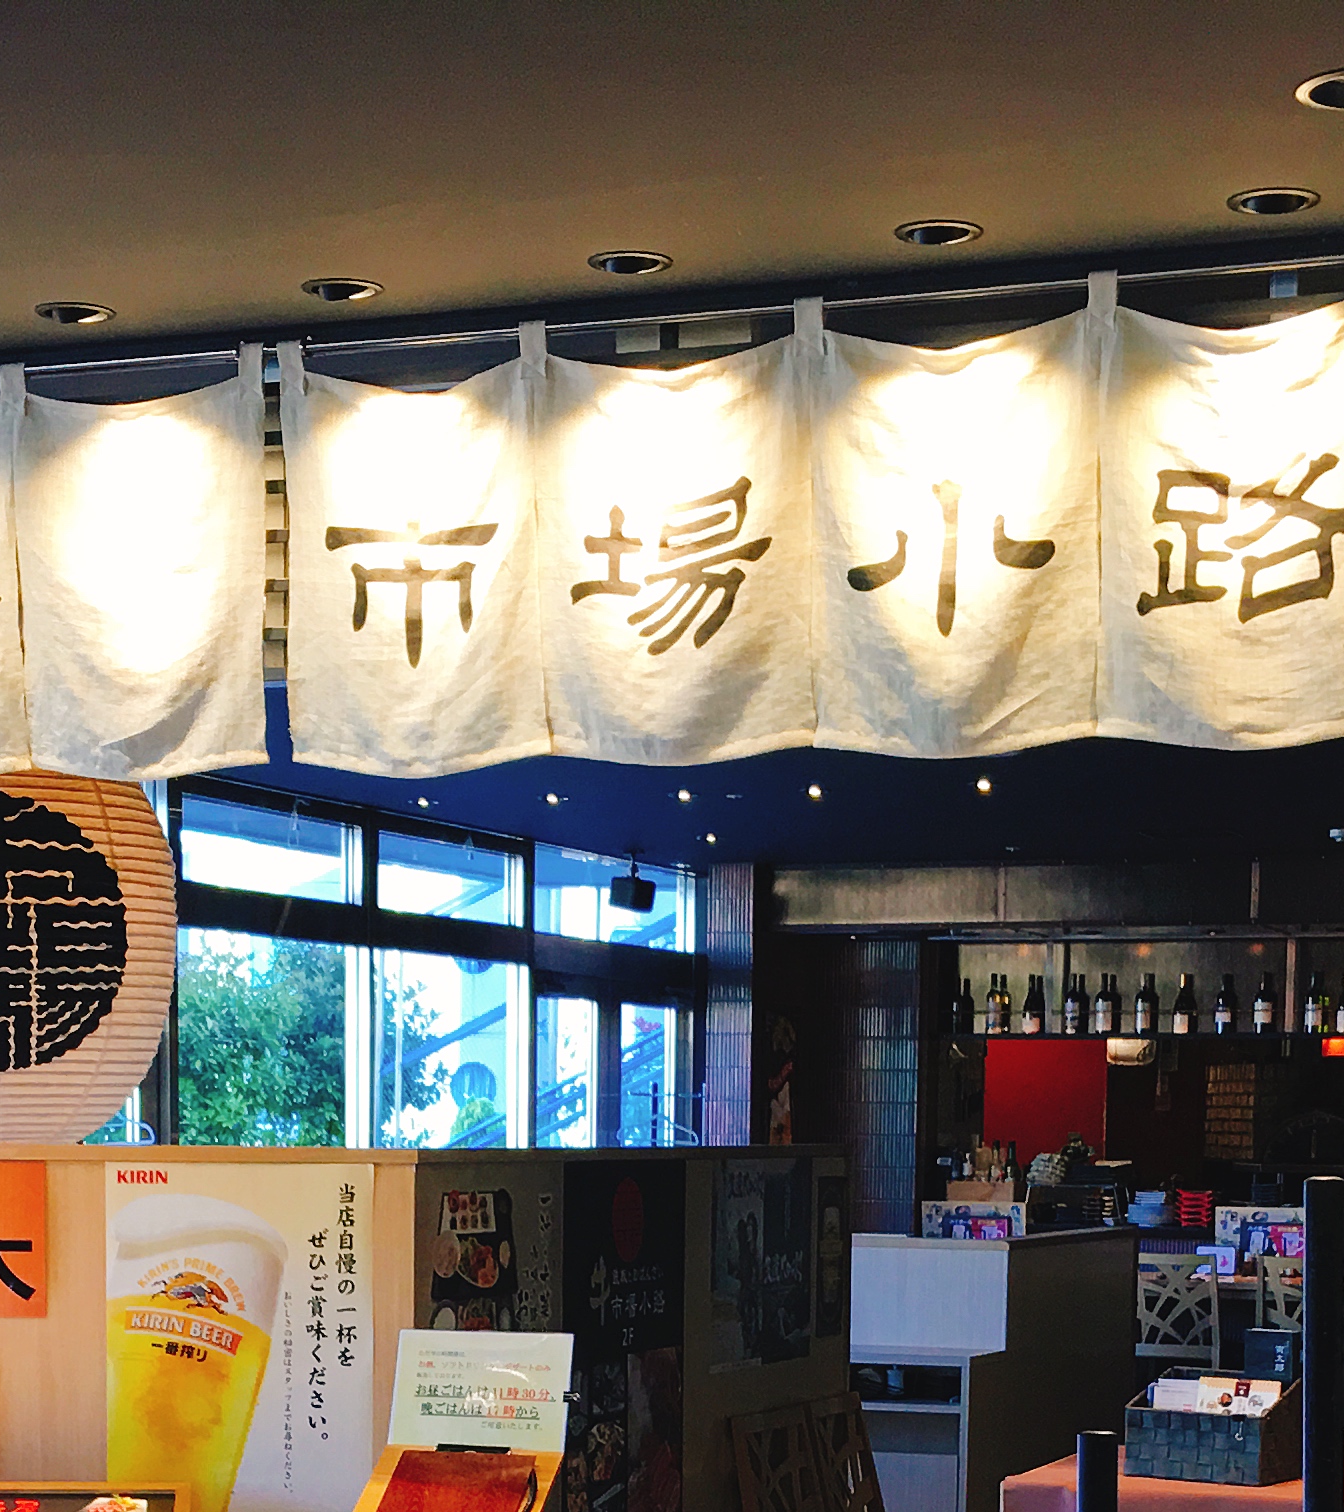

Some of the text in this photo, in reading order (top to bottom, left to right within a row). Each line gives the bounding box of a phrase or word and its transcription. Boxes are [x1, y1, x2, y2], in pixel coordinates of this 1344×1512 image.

[117, 1169, 169, 1185] KIRIN
[184, 1256, 225, 1281] PRIME
[335, 1182, 358, 1367] 当店自慢の一杯を
[131, 1311, 234, 1350] KIRIN BEER
[305, 1227, 329, 1441] ぜひご賞味ください。
[621, 1326, 635, 1347] 2F
[151, 1340, 208, 1362] 一番搾り
